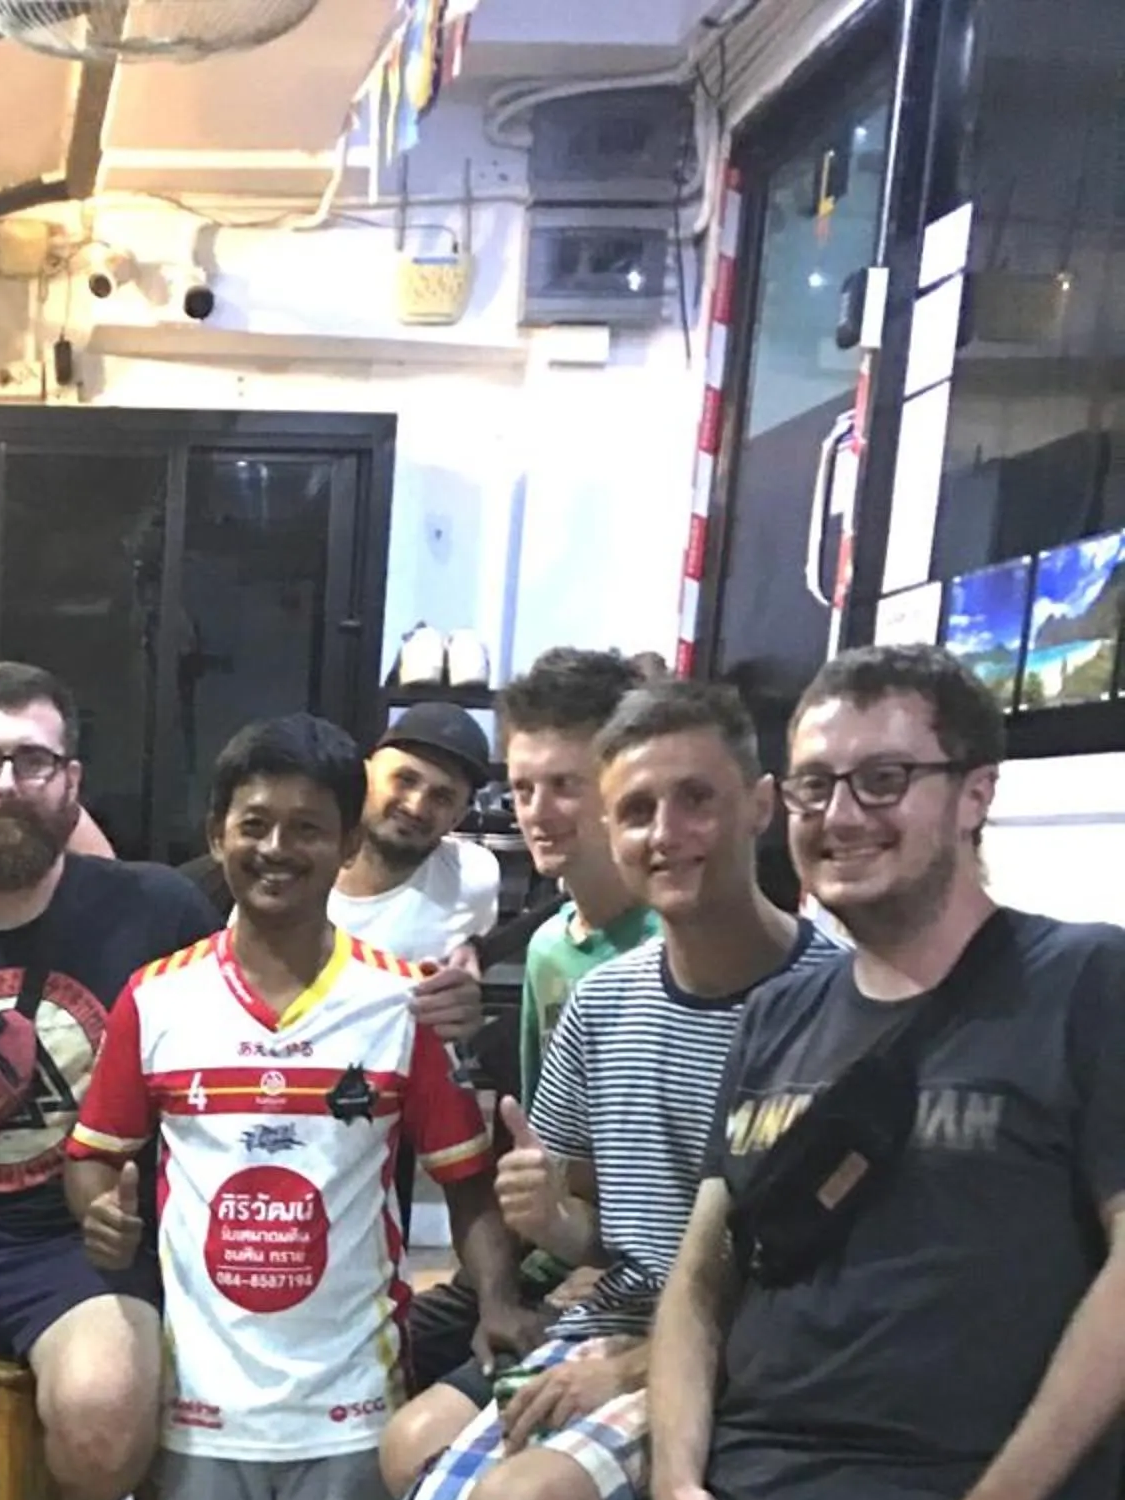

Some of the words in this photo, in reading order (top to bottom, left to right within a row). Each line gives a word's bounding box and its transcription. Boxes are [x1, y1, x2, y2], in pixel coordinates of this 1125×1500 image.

[187, 1071, 208, 1112] 4
[218, 1192, 315, 1221] ศิริวัฒน์
[350, 1397, 386, 1417] SCG
